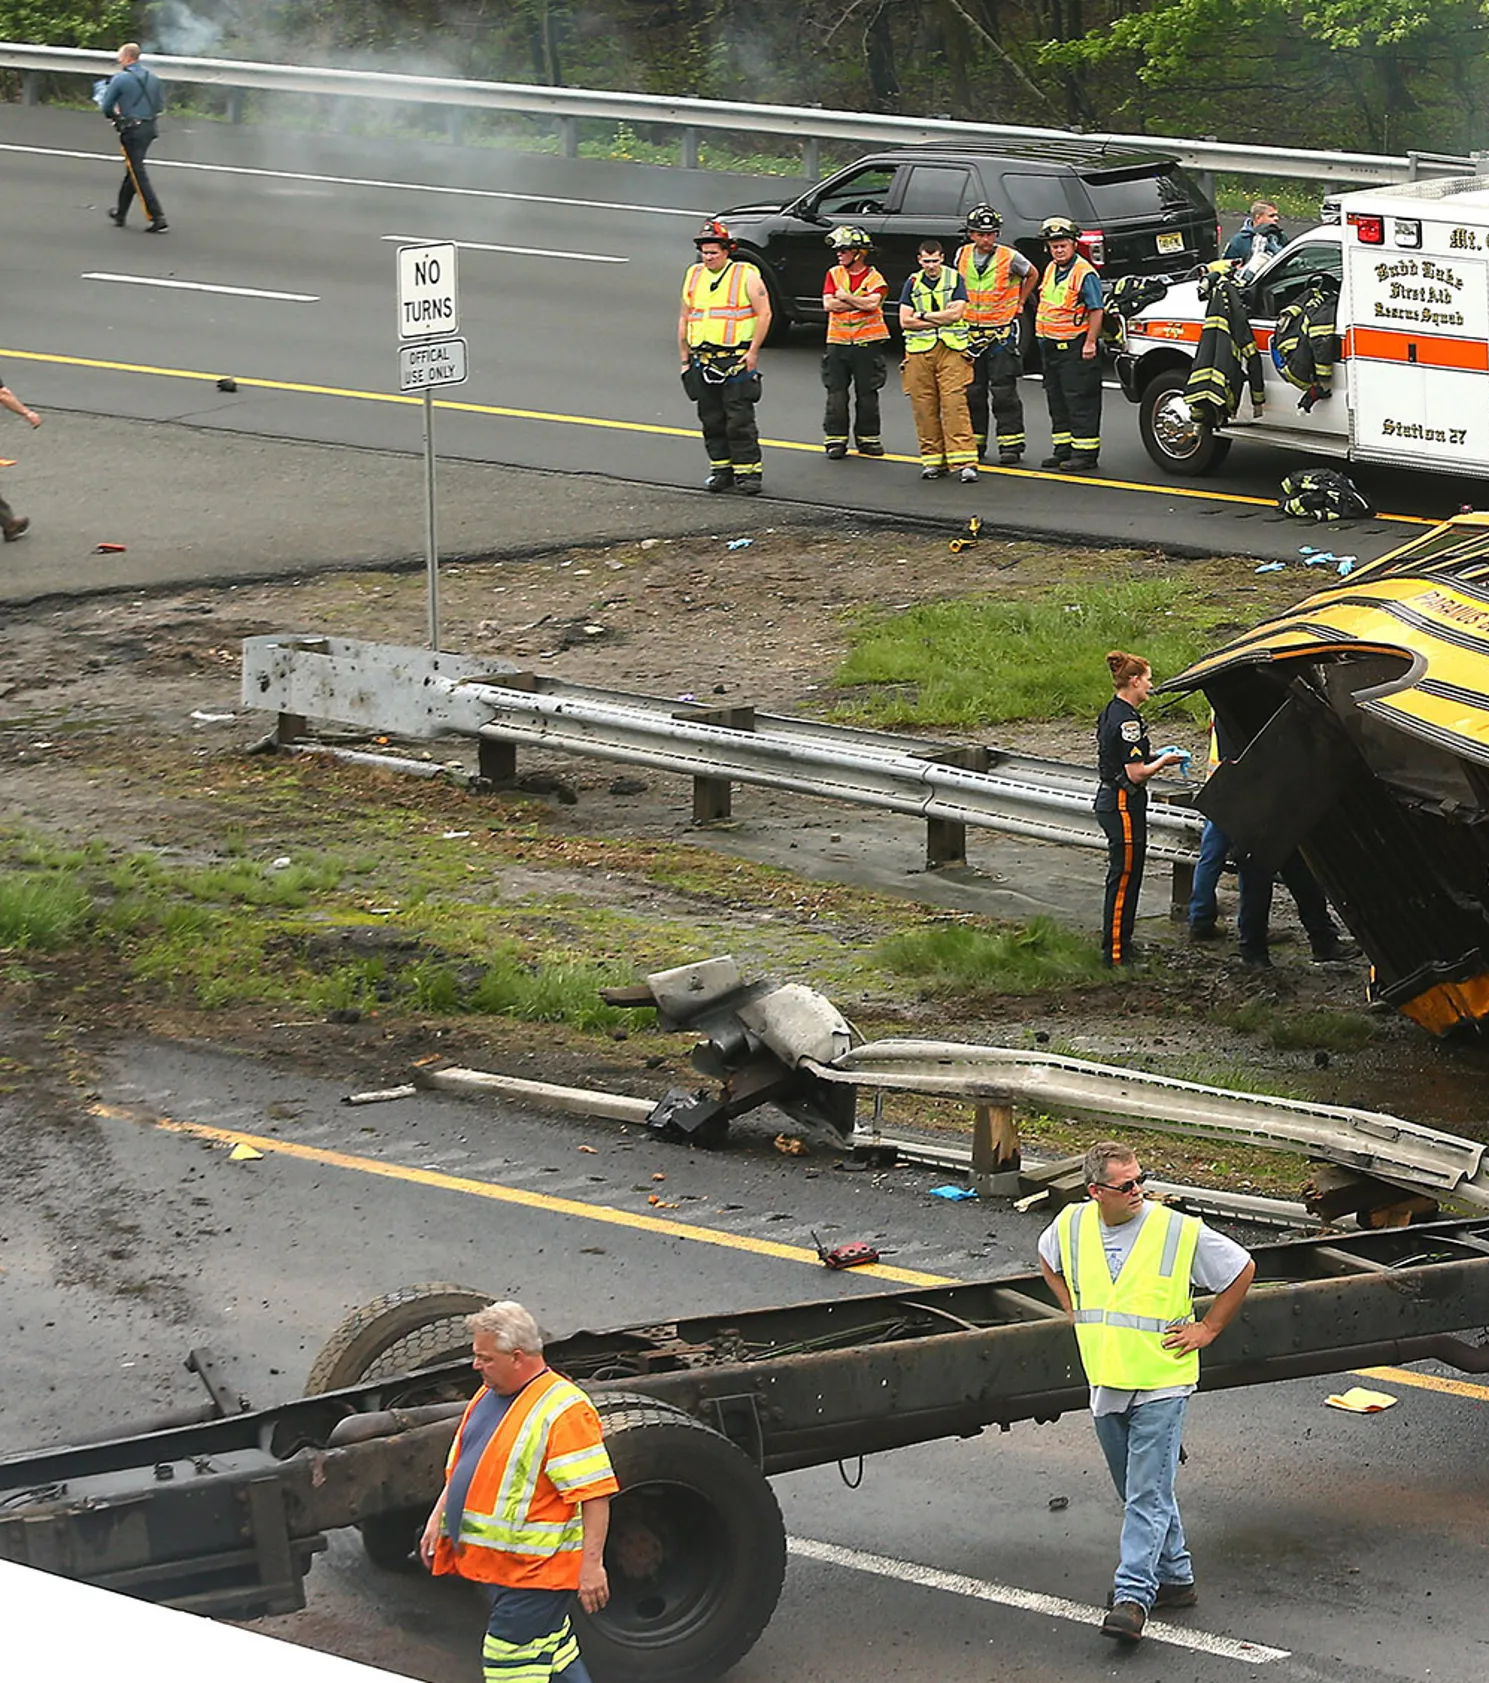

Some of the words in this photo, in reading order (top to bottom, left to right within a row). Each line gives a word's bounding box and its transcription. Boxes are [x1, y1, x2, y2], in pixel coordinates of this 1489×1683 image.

[1449, 227, 1482, 251] Mt.
[414, 258, 441, 286] NO
[1374, 259, 1418, 283] Budd
[1421, 260, 1464, 291] Lake
[1389, 281, 1426, 303] First
[1427, 286, 1452, 304] Aid
[403, 297, 453, 322] TURNS
[1374, 301, 1420, 322] Rescue
[1420, 307, 1464, 327] Squad
[405, 368, 424, 384] USE
[429, 363, 456, 380] ONLY
[1381, 418, 1446, 443] Station
[1448, 427, 1468, 445] 27
[1413, 589, 1489, 625] PARAMUS
